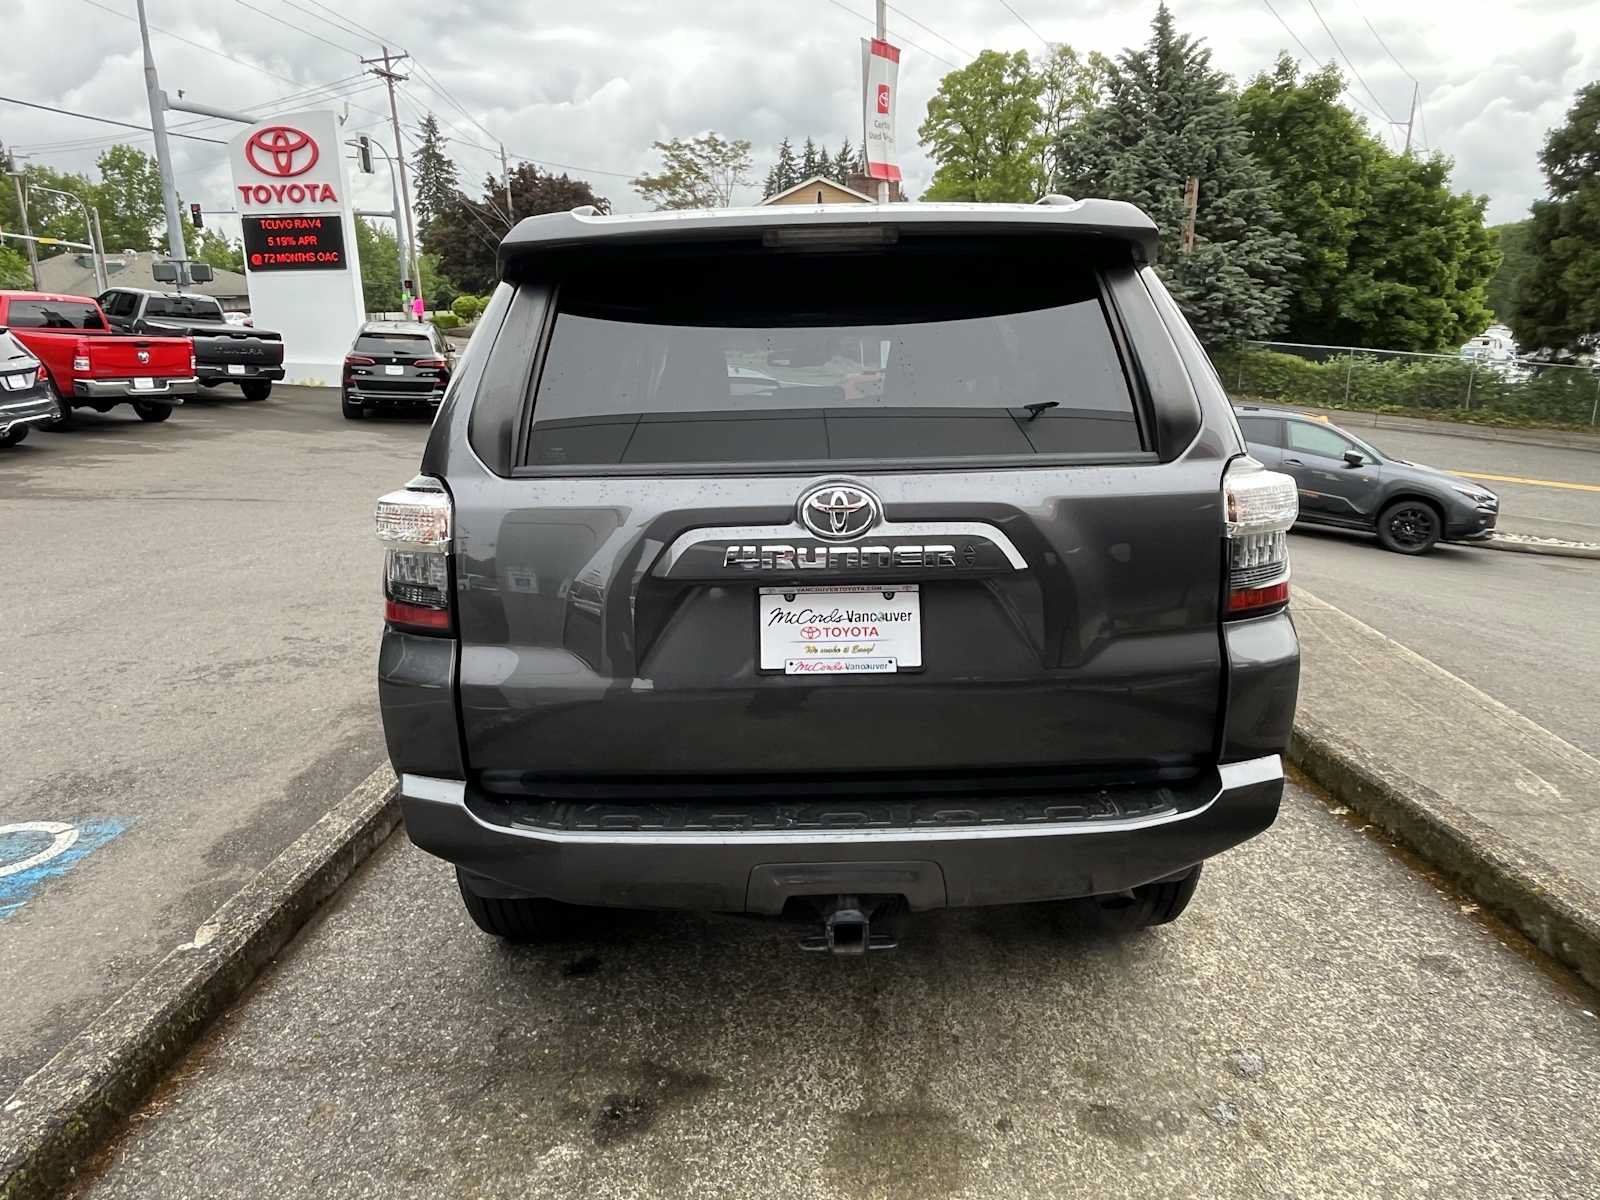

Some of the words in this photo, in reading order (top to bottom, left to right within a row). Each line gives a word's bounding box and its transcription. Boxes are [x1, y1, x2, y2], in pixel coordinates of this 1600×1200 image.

[238, 183, 338, 205] TOYOTA
[260, 219, 293, 230] TCUVG
[294, 218, 322, 229] RAV4
[297, 235, 318, 246] APR
[264, 253, 276, 264] 72
[276, 252, 316, 263] MONTHS
[316, 251, 339, 262] OAC
[723, 545, 956, 569] 4RUNNER
[768, 607, 846, 627] McCords
[846, 609, 913, 624] Vancouver
[822, 626, 880, 638] TOYOTA
[793, 660, 845, 673] McCords
[845, 662, 888, 671] Vancouver
